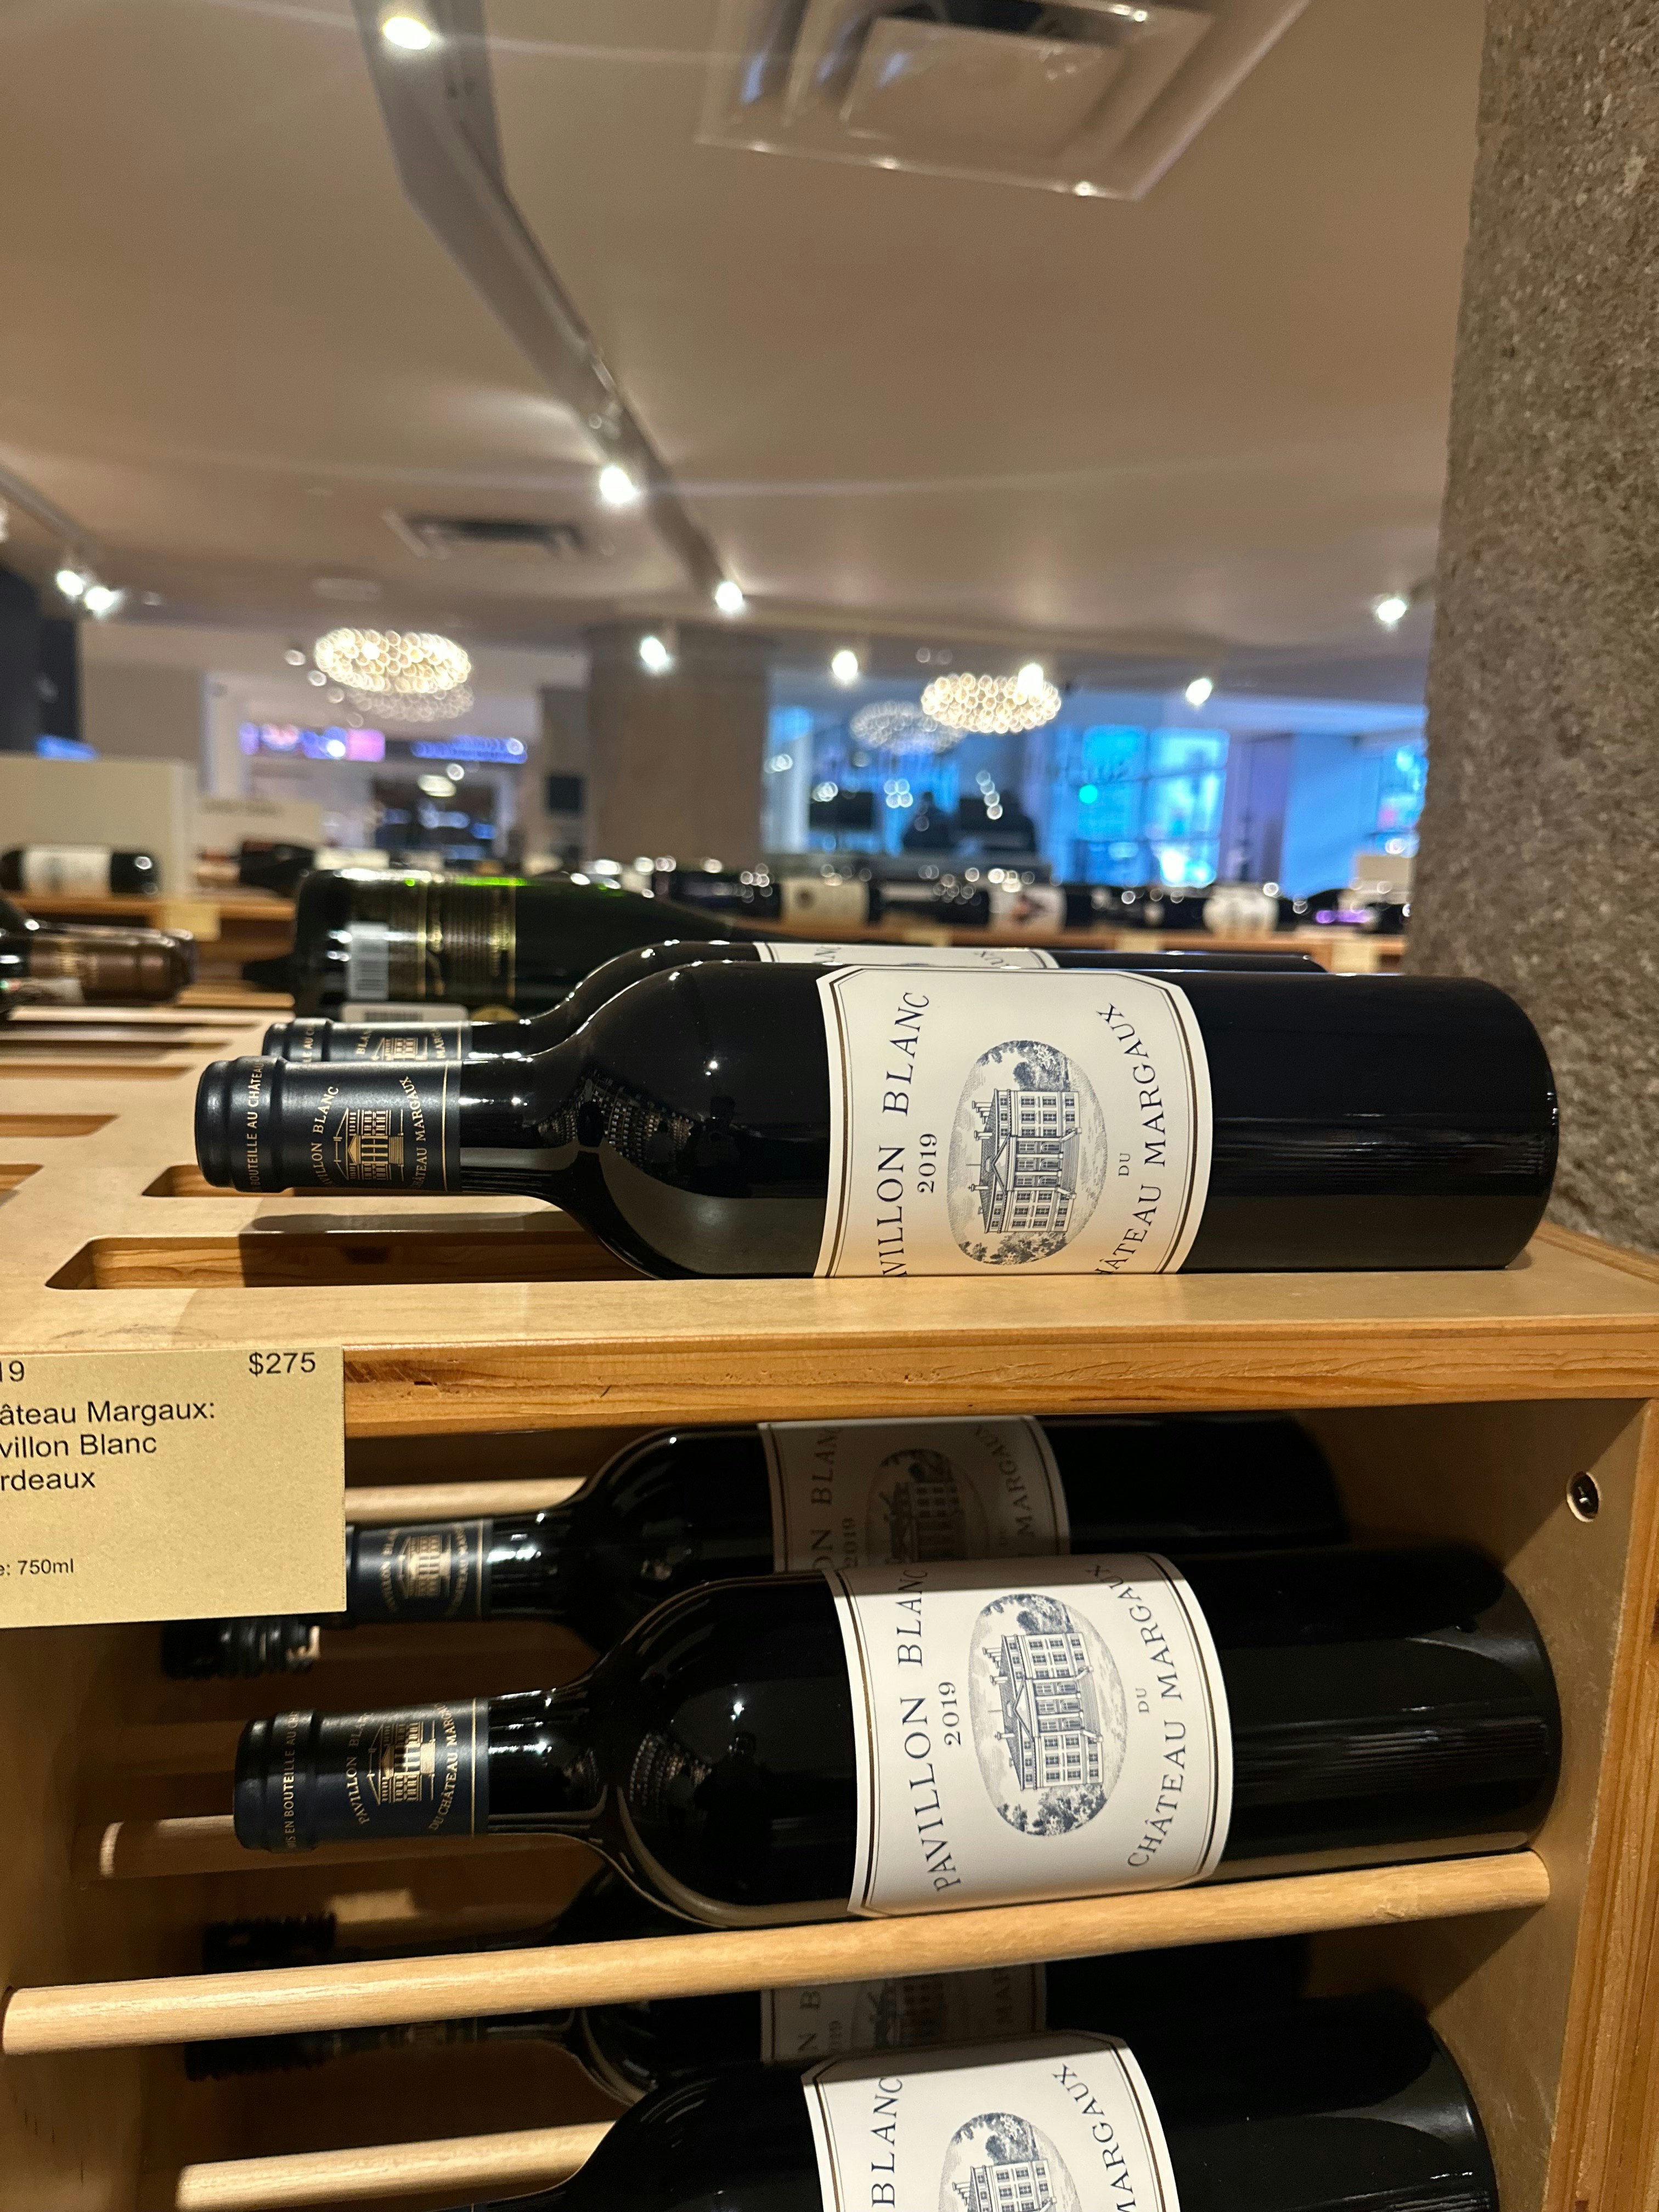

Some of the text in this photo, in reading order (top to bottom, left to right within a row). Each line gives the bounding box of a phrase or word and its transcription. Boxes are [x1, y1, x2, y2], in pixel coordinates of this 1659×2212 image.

[356, 1029, 374, 1054] BLAN
[431, 1028, 447, 1059] MARG
[248, 1062, 264, 1108] CHÂTEAU
[1096, 1003, 1166, 1167] MARGAUX
[247, 1111, 258, 1128] AU
[313, 1086, 339, 1135] BLANC
[399, 1076, 428, 1188] HÂTEAU MARGAUX
[876, 992, 929, 1277] VILLON BLANC
[247, 1133, 261, 1186] BOUTEILLE
[917, 1133, 937, 1193] 2019
[1118, 1152, 1130, 1176] DU
[0, 1352, 317, 1381] 19 $275
[0, 1400, 216, 1426] âteau Margaux:
[0, 1434, 157, 1458] villon Blanc
[1, 1469, 96, 1491] rdeaux
[18, 1558, 74, 1575] 750ml
[938, 1681, 961, 1746] 2019
[1085, 1565, 1187, 1867] CHÂTEAU MARGAUX
[1136, 1688, 1150, 1713] DU
[286, 1731, 297, 1746] AU
[897, 1569, 961, 1891] PAVILLON BLANC
[283, 1750, 295, 1818] BOUTEILLE
[346, 1757, 370, 1824] PAVILLON
[429, 1815, 443, 1830] DU
[439, 1752, 458, 1815] CHÂTEAU
[285, 1820, 295, 1834] EN
[871, 2076, 903, 2208] BLANC
